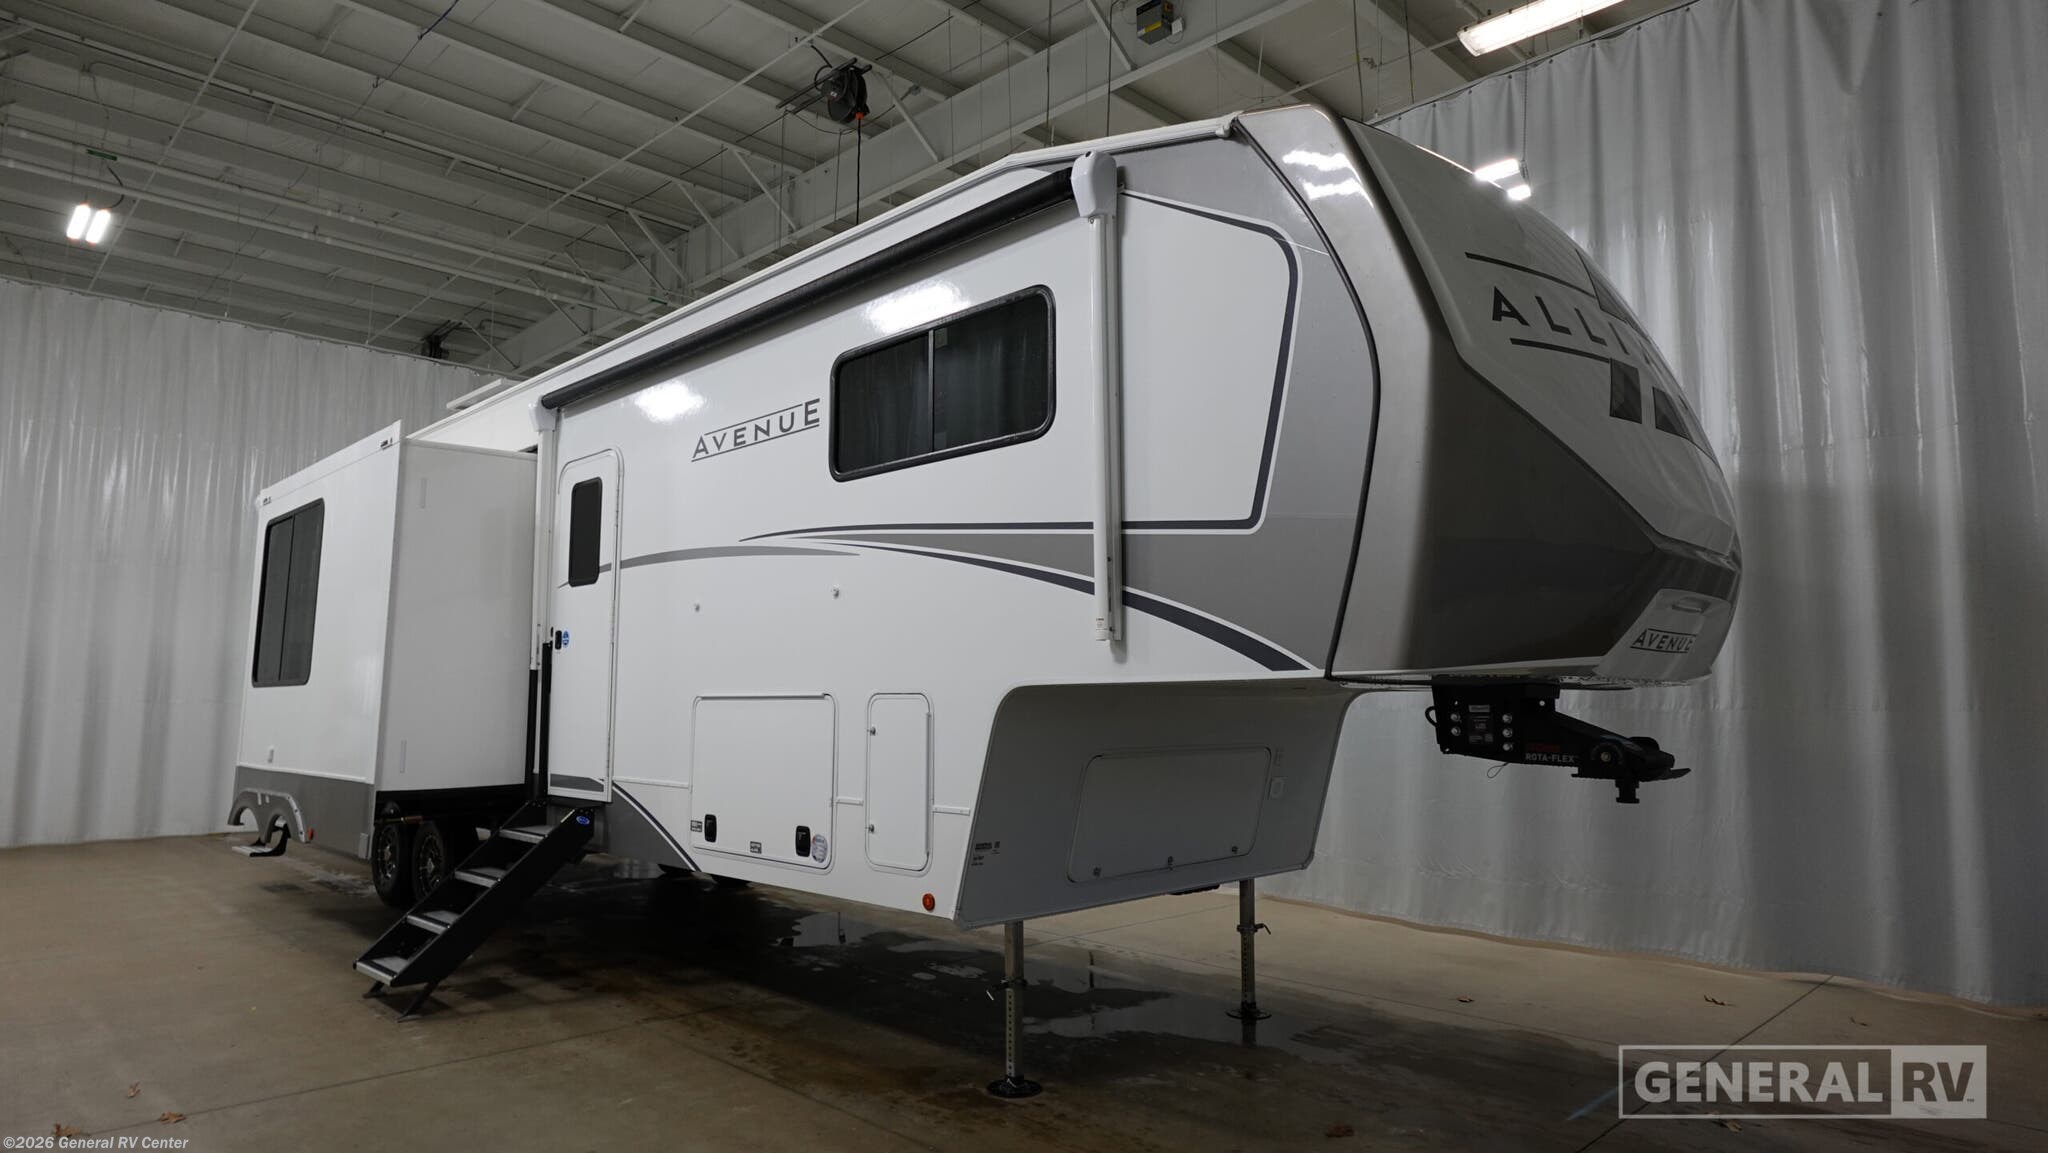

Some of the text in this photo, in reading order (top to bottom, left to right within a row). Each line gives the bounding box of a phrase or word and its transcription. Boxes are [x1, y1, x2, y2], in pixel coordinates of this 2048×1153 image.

[1492, 286, 1650, 365] ALLI
[692, 398, 820, 459] AVENUE
[1632, 629, 1693, 651] AVENUE
[1525, 752, 1575, 763] ROTA-FLEX
